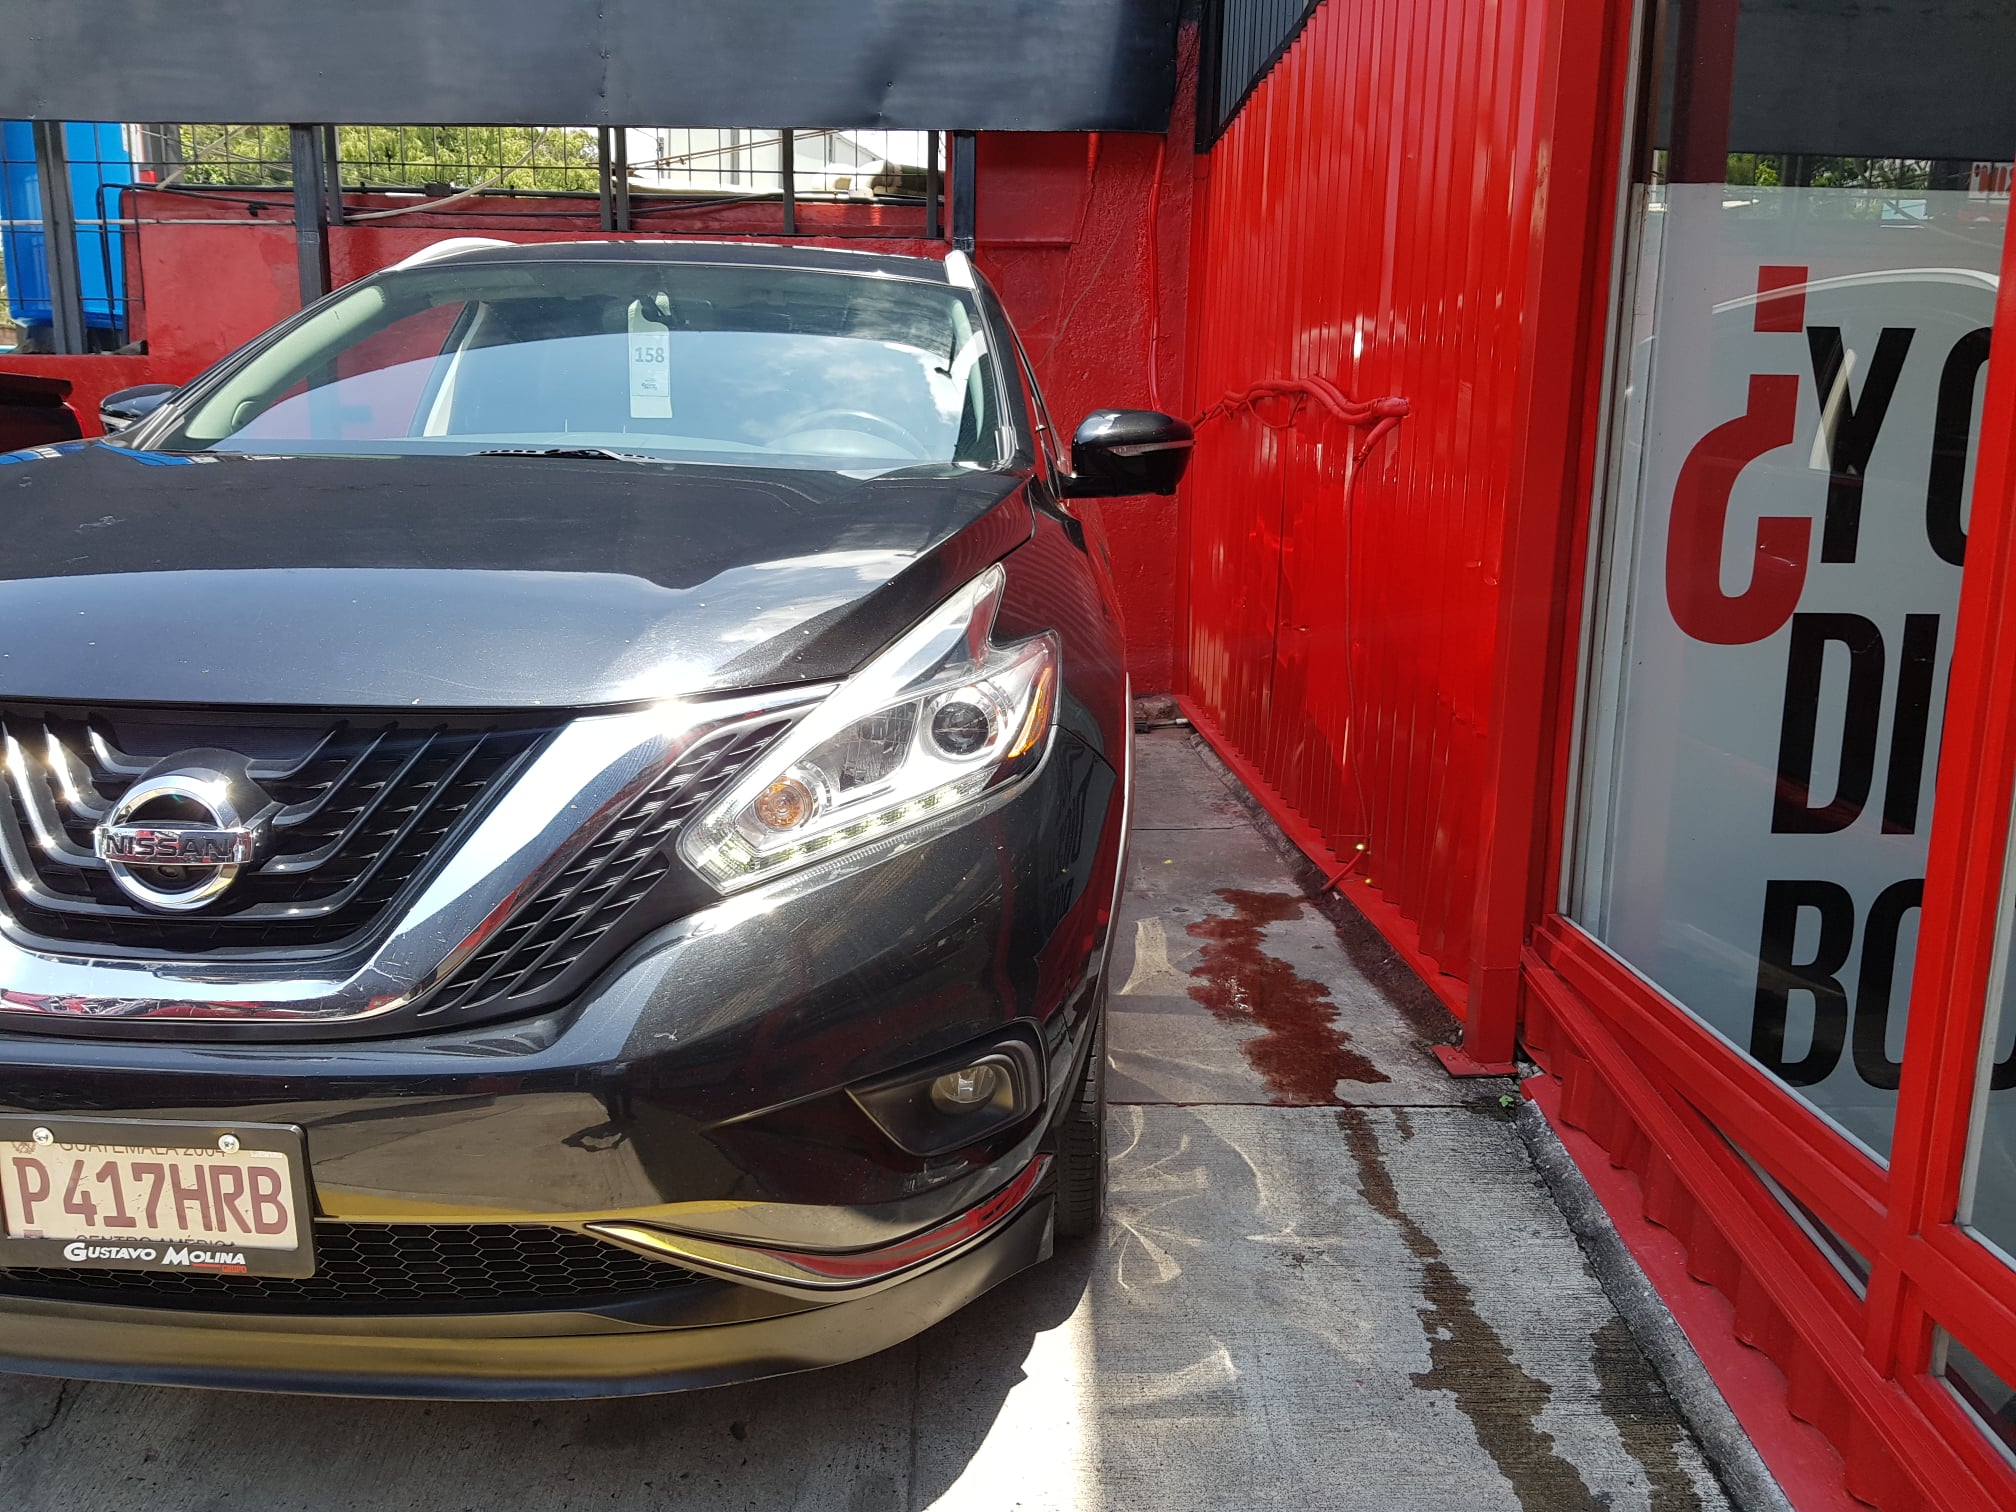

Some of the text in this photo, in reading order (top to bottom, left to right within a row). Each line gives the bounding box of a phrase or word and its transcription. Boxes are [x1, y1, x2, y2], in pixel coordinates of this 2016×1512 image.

[635, 347, 665, 363] 158
[1771, 613, 1952, 835] DI
[106, 834, 231, 859] NISSAN
[63, 1242, 246, 1266] GUSTAVO MOLINA
